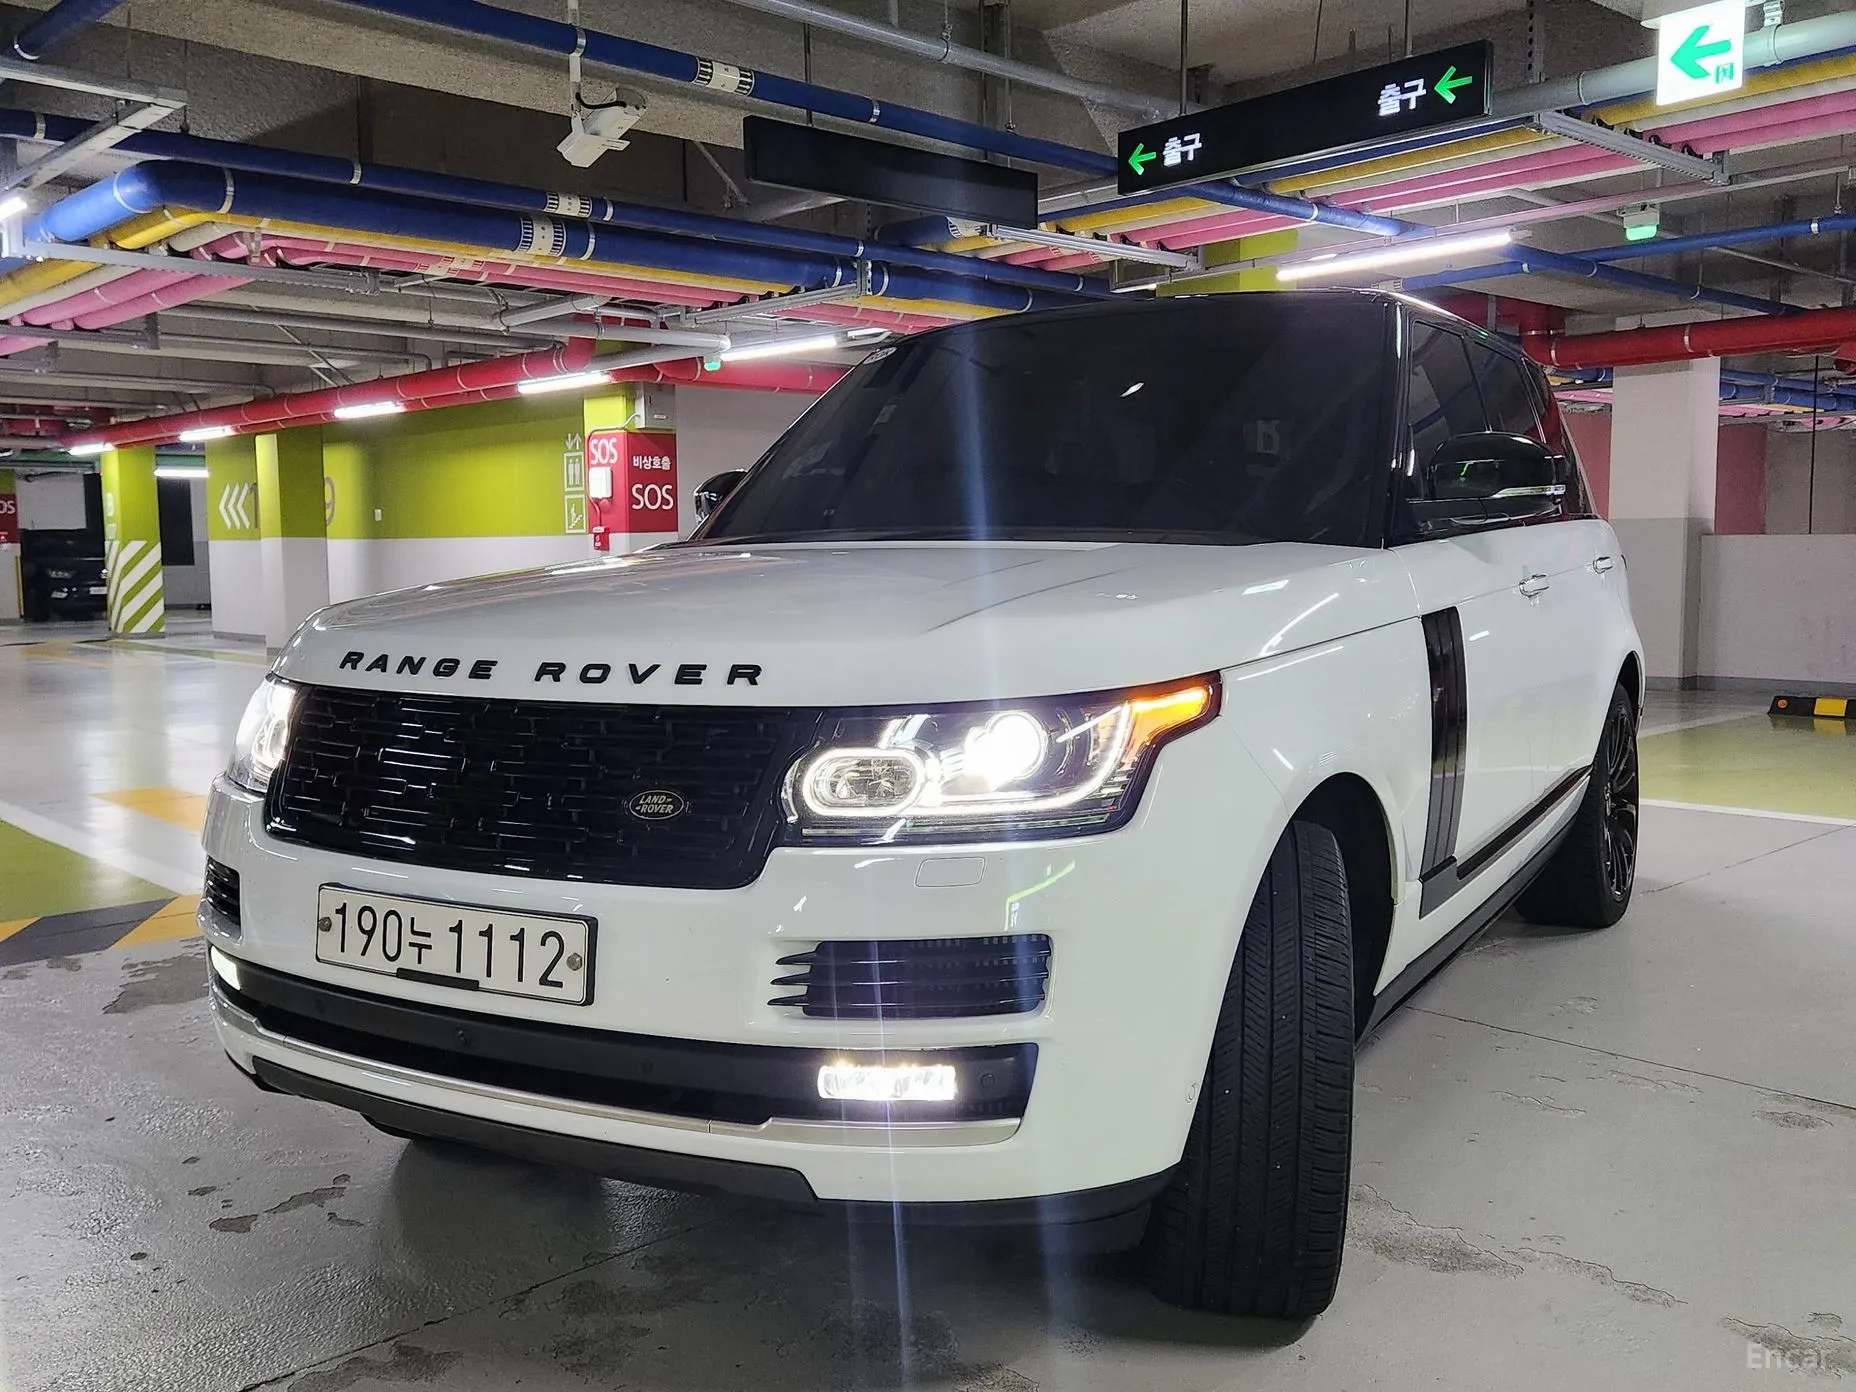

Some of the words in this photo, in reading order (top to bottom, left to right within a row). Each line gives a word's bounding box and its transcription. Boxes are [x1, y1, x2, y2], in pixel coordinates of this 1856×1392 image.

[1376, 78, 1426, 116] 출구
[1163, 132, 1202, 167] 출구
[589, 438, 618, 464] SOS
[632, 456, 671, 470] 비상호출
[631, 483, 674, 510] SOS
[339, 651, 498, 680] RANGE
[534, 662, 762, 686] ROVER
[639, 795, 667, 804] LAND
[640, 804, 674, 814] ROVER
